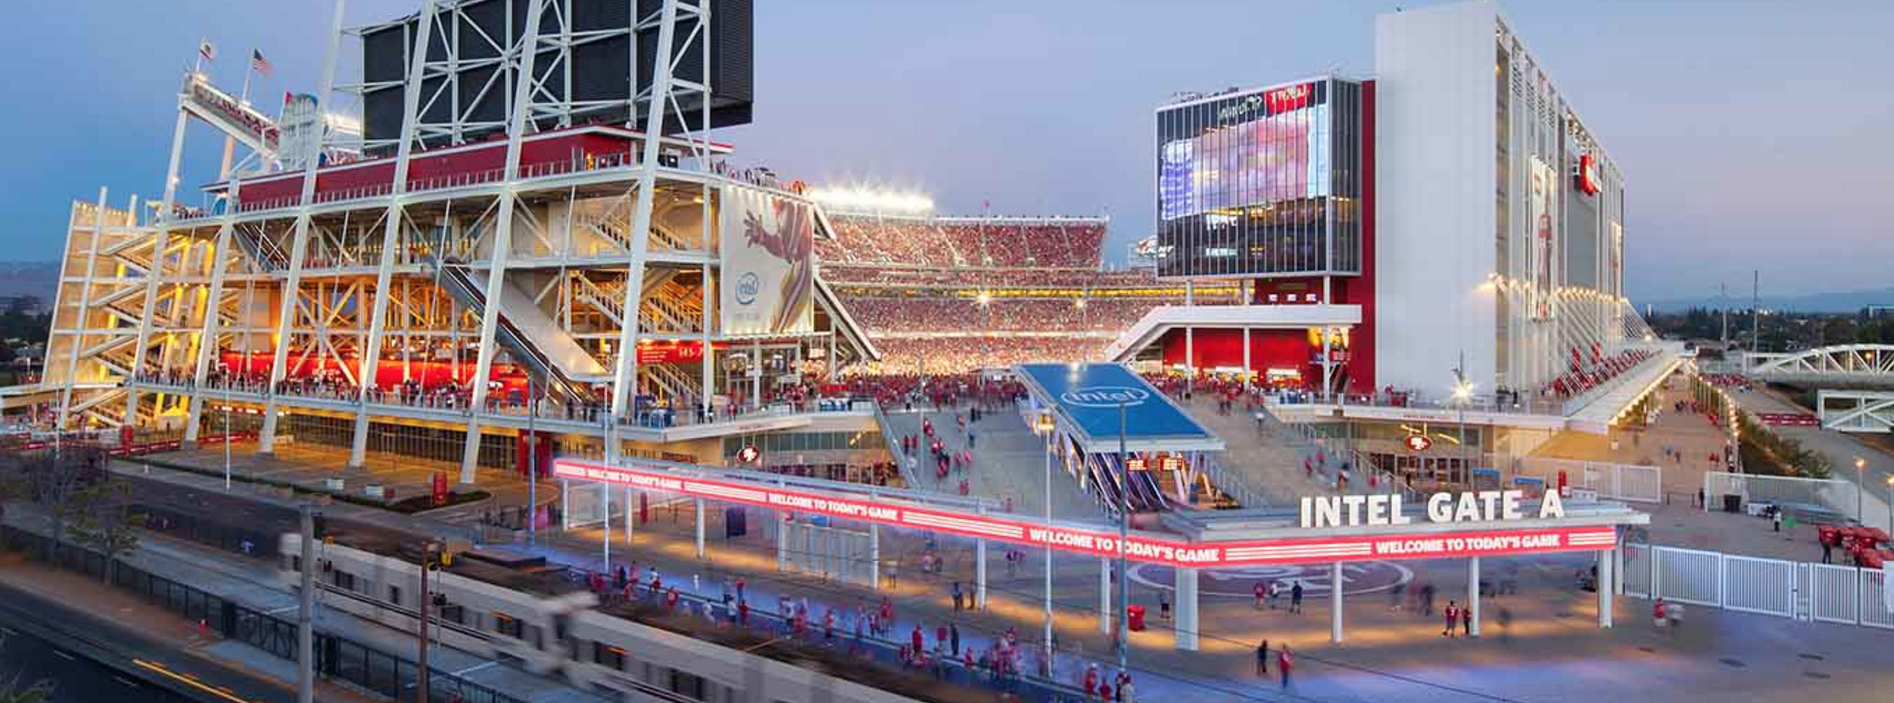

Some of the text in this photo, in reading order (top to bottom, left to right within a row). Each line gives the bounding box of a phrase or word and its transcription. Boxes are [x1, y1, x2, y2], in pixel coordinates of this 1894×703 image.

[768, 492, 898, 521] WELCOME TO TODAY'S GAME
[1300, 489, 1566, 528] INTEL GATE A
[1029, 528, 1220, 562] WELCOME TO TODAY'S GAME
[1375, 533, 1560, 554] WELCOME TO TODAY'S GAME
